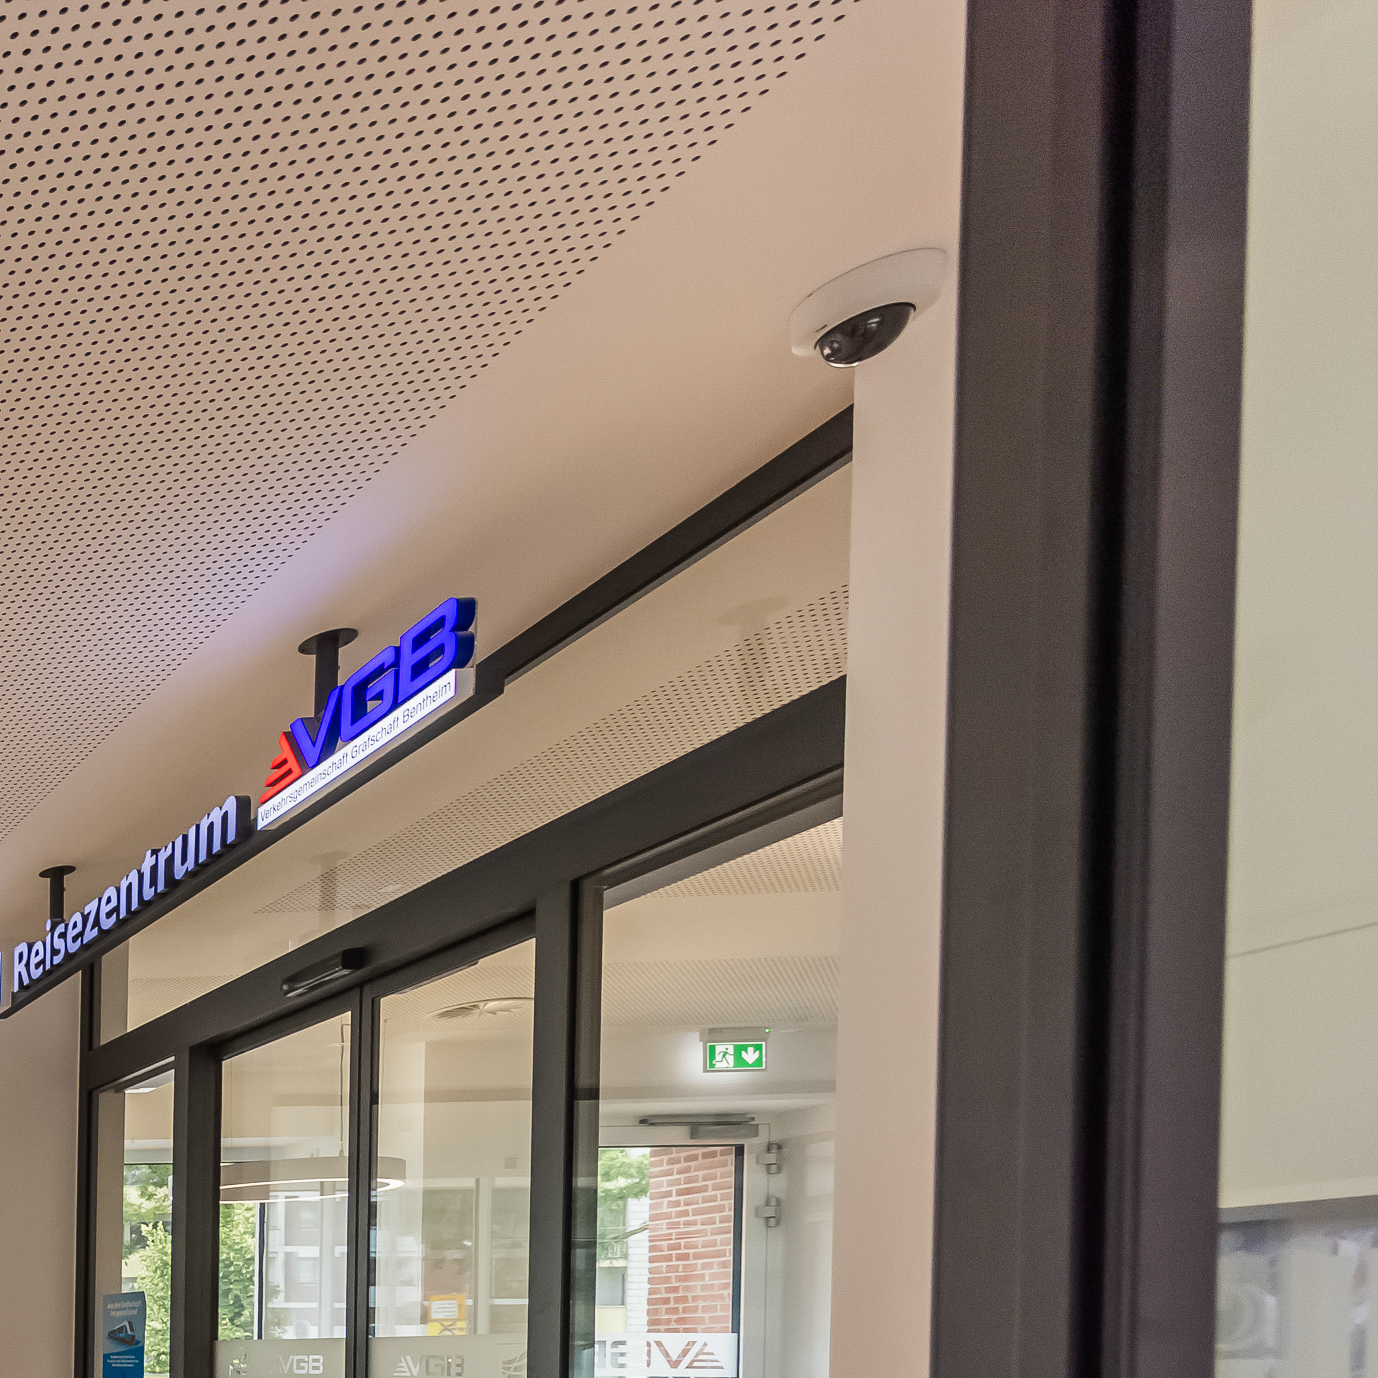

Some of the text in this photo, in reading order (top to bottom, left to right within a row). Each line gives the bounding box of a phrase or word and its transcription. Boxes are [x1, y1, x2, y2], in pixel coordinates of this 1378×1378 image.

[259, 680, 452, 822] Verkehrsgemeinschaft Grafschaft Bentheim
[289, 596, 459, 769] VGB
[13, 794, 238, 993] Reisezentrum
[278, 1354, 324, 1375] VGB
